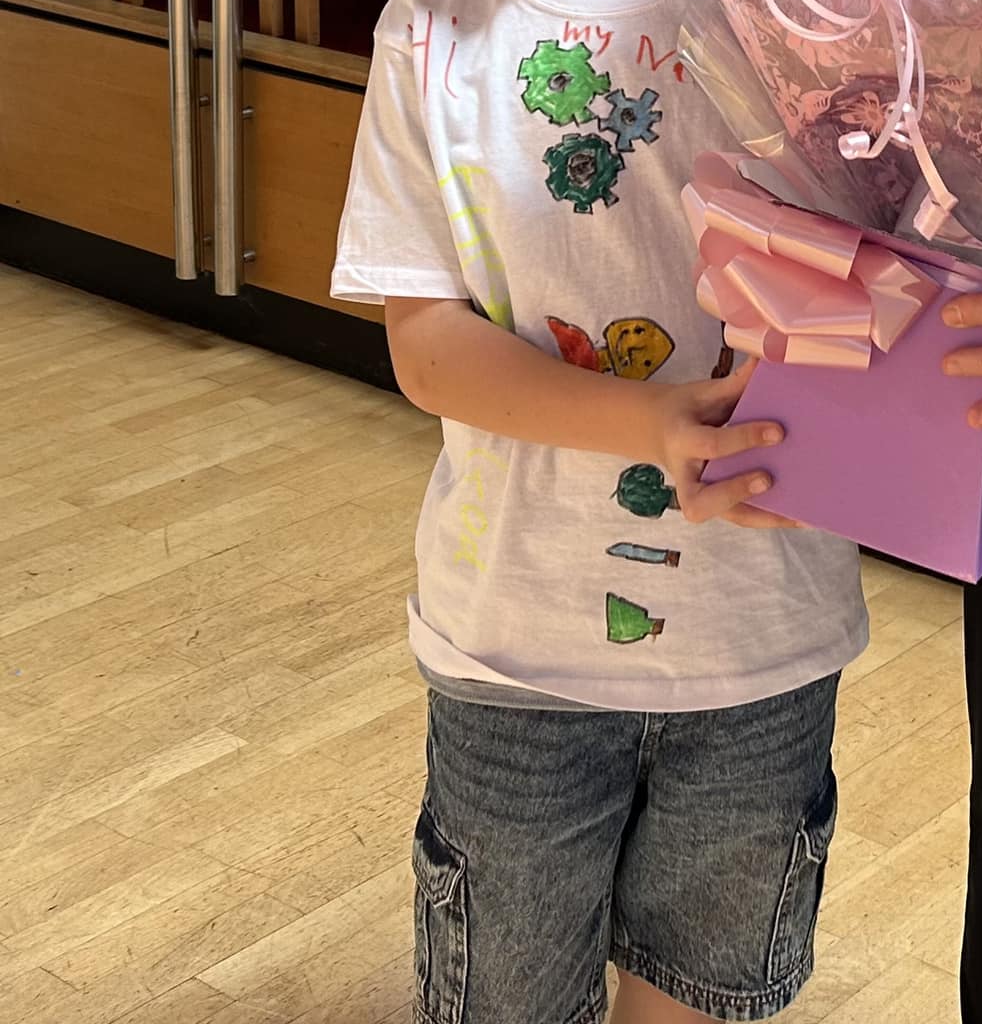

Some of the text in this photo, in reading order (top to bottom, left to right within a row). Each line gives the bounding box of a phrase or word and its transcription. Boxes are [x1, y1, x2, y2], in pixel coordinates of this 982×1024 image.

[408, 9, 685, 100] Hi my N
